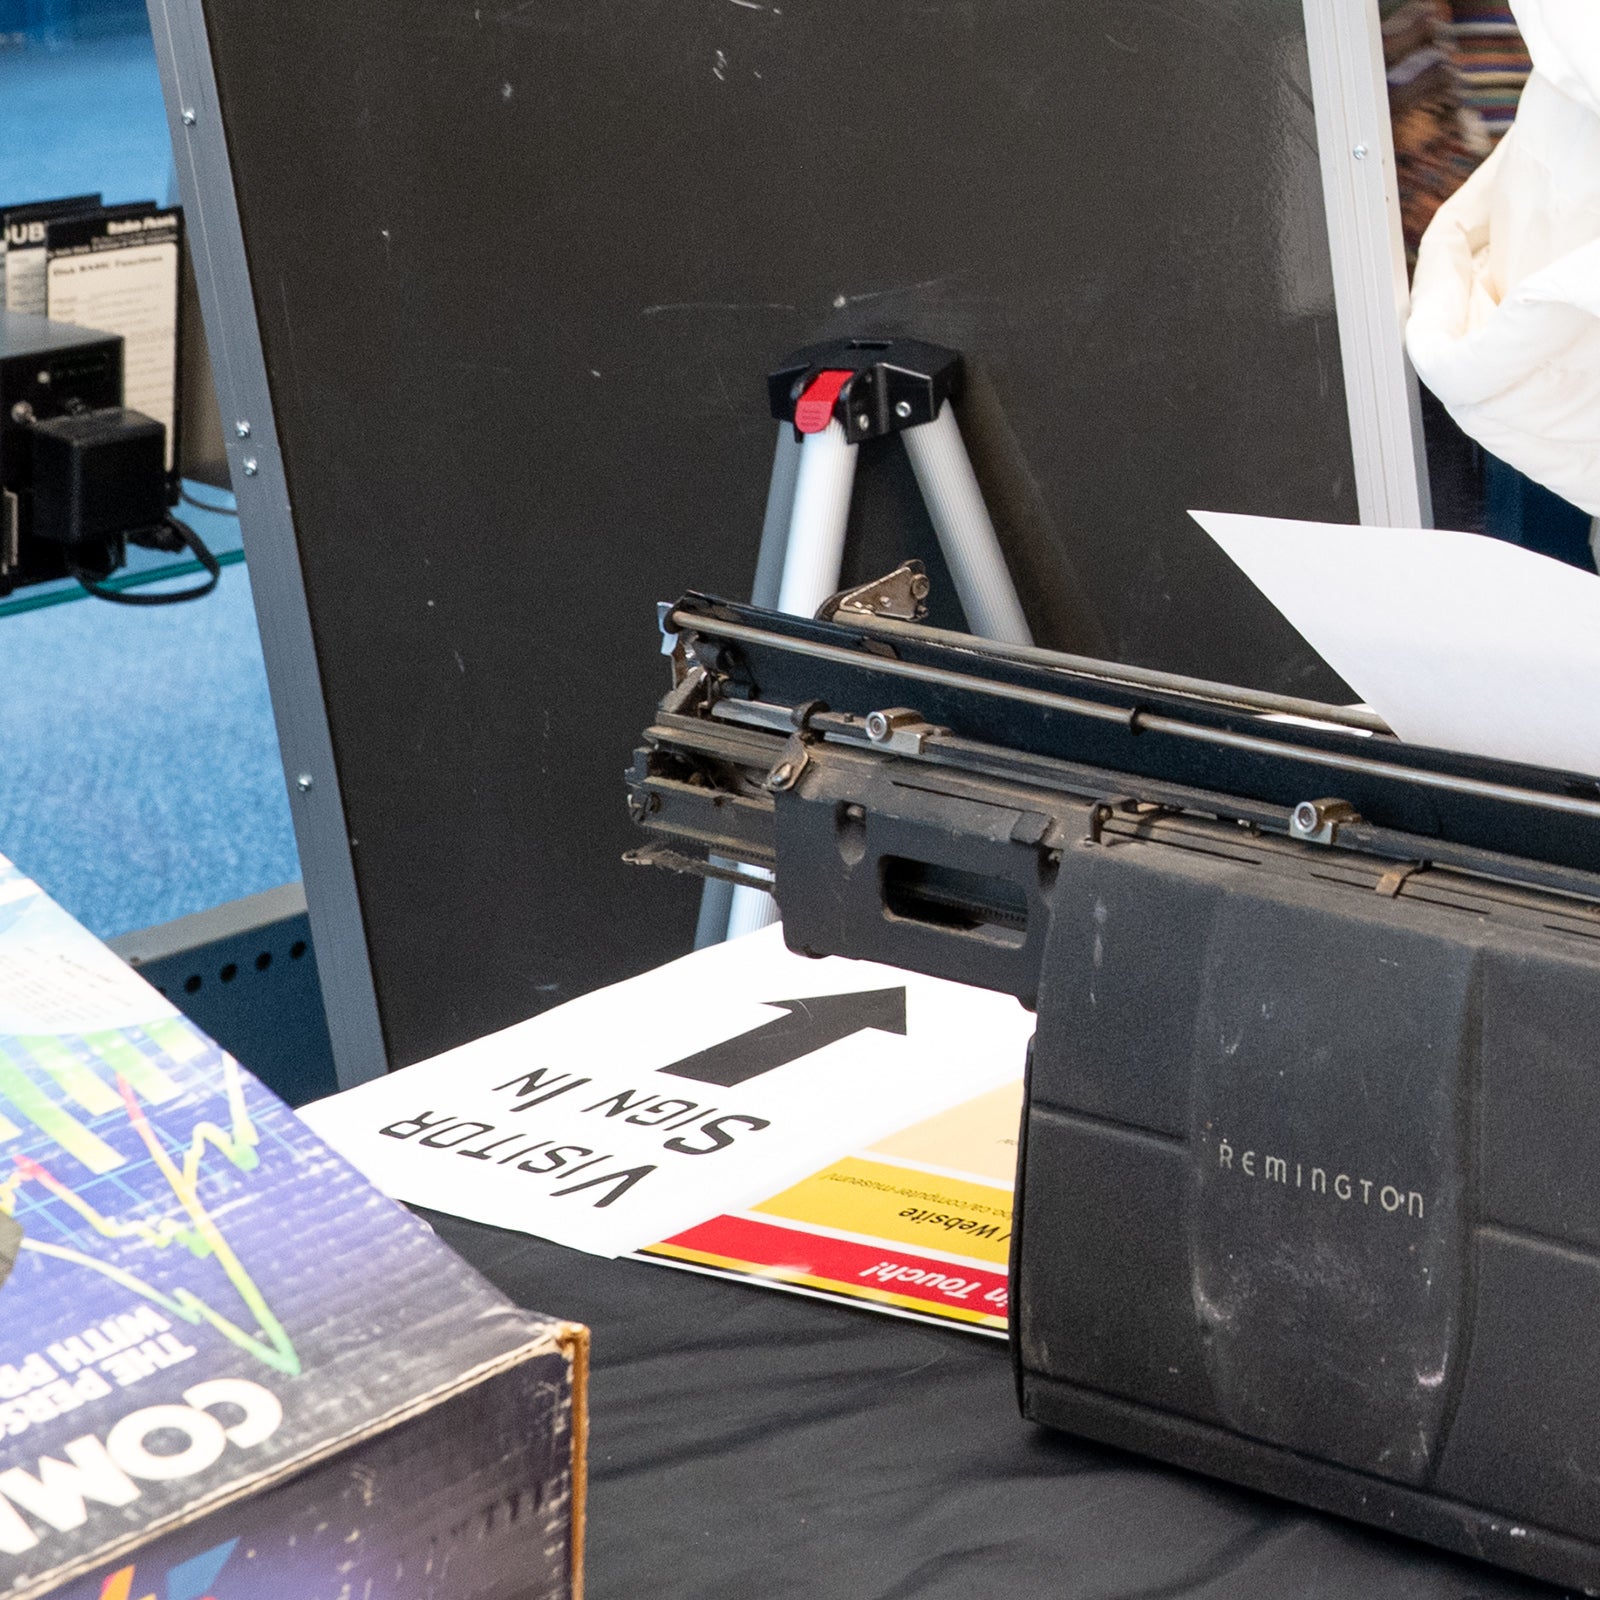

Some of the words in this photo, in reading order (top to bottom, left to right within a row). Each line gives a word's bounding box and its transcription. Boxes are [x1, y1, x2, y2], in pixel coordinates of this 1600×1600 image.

[491, 1067, 593, 1112] IN
[580, 1089, 771, 1156] SIGN
[378, 1110, 658, 1209] VISITOR
[1219, 1143, 1424, 1218] REMINGTON
[820, 1173, 1013, 1221] oo.ca/computer-museum/
[898, 1207, 1001, 1239] Website
[858, 1261, 982, 1299] Touch!
[46, 1305, 172, 1373] WITH
[100, 1332, 198, 1387] THE
